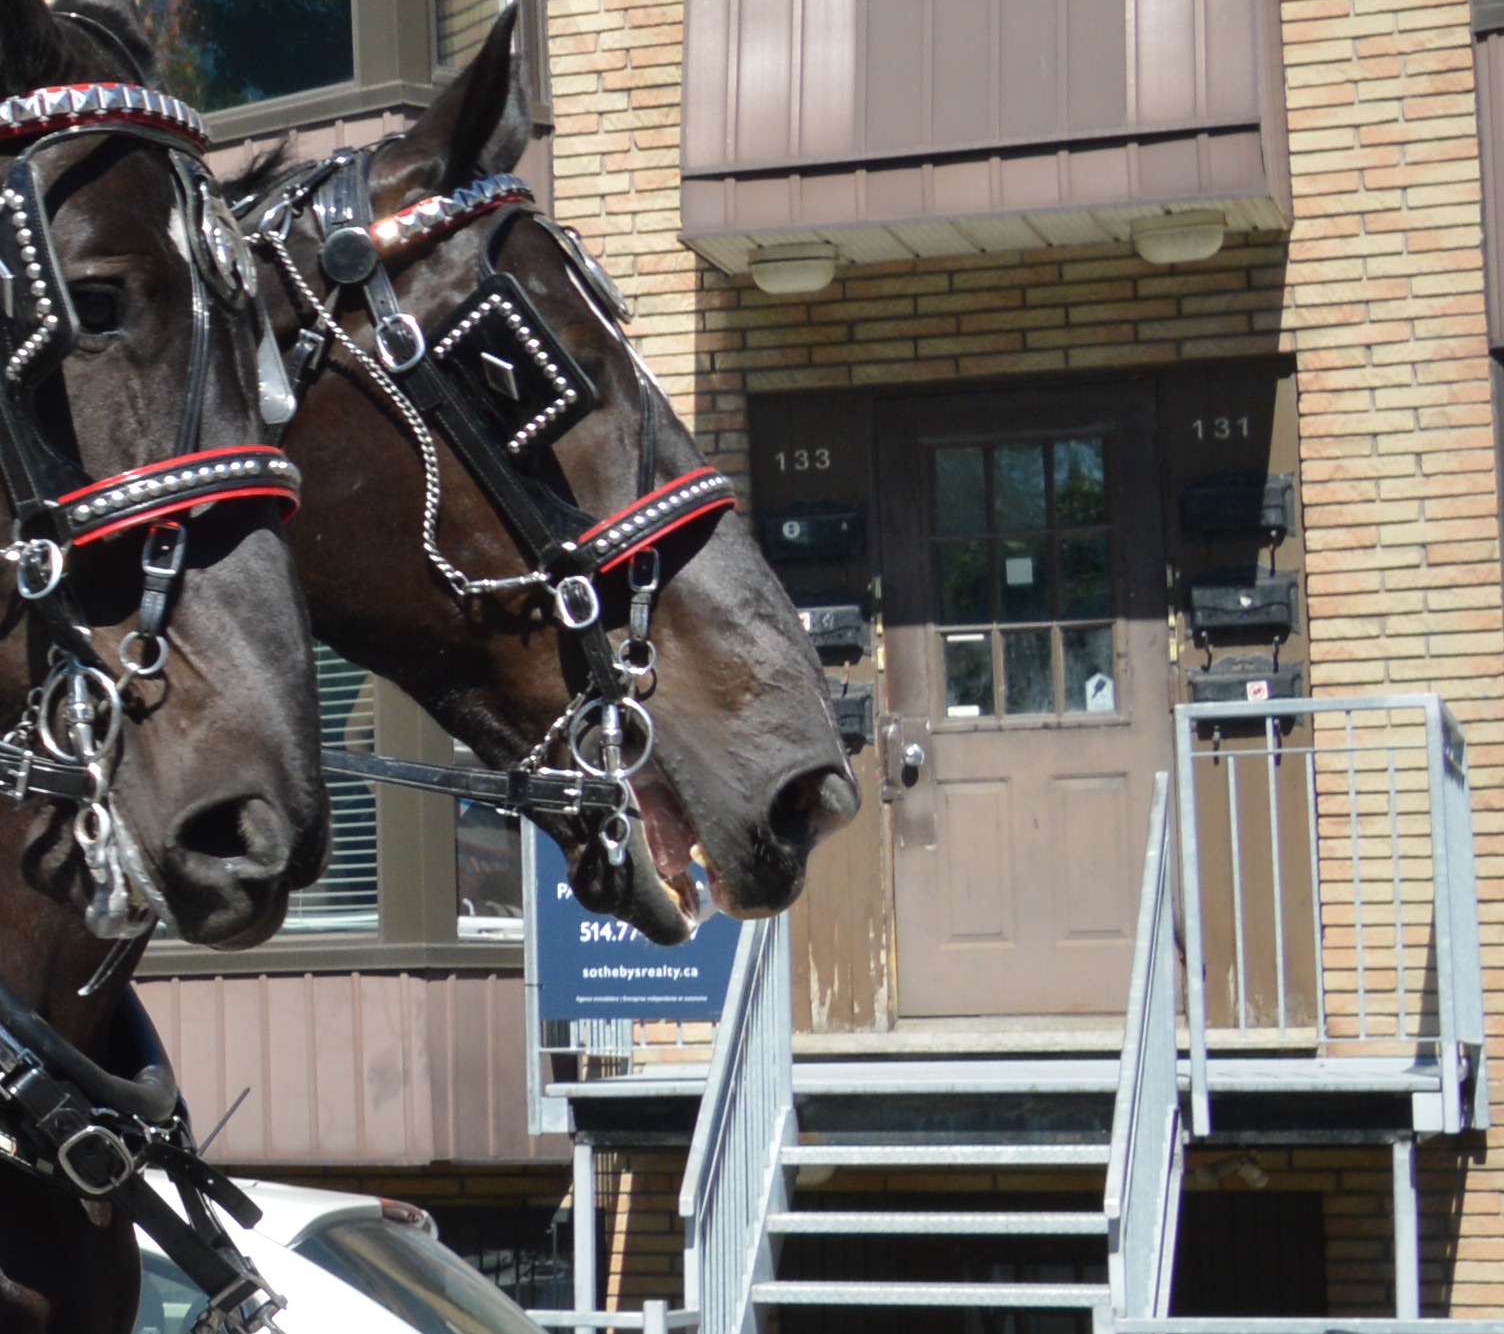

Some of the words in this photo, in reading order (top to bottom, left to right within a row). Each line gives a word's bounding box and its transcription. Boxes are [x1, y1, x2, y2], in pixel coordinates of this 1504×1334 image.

[1191, 416, 1249, 440] 131
[774, 448, 831, 471] 133
[582, 964, 699, 981] sothebysrealty.ca
